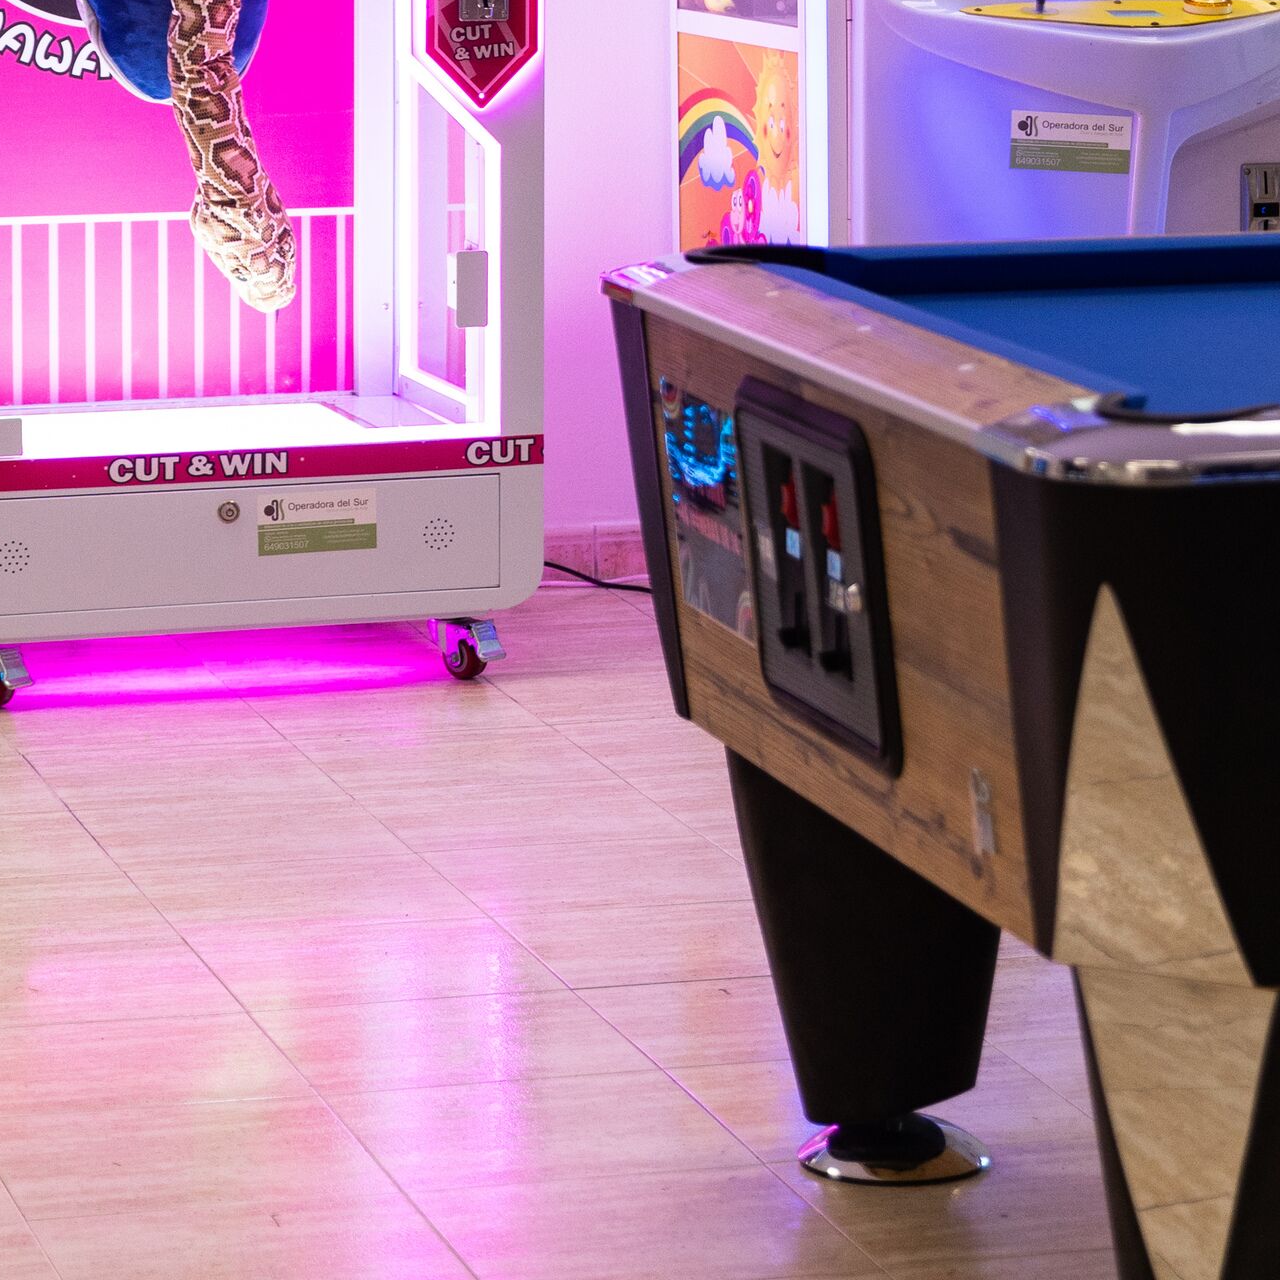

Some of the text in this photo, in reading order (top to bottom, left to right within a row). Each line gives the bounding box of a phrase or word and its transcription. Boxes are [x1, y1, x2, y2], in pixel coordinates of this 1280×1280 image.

[449, 23, 492, 43] CUT
[454, 41, 514, 61] & WIN
[1041, 119, 1124, 133] Operadora del Sur
[465, 437, 535, 466] CUT
[108, 450, 289, 484] CUT & WIN
[287, 501, 335, 512] Operadora
[336, 498, 351, 507] del
[352, 497, 369, 507] Sur
[264, 540, 310, 552] 649031507
